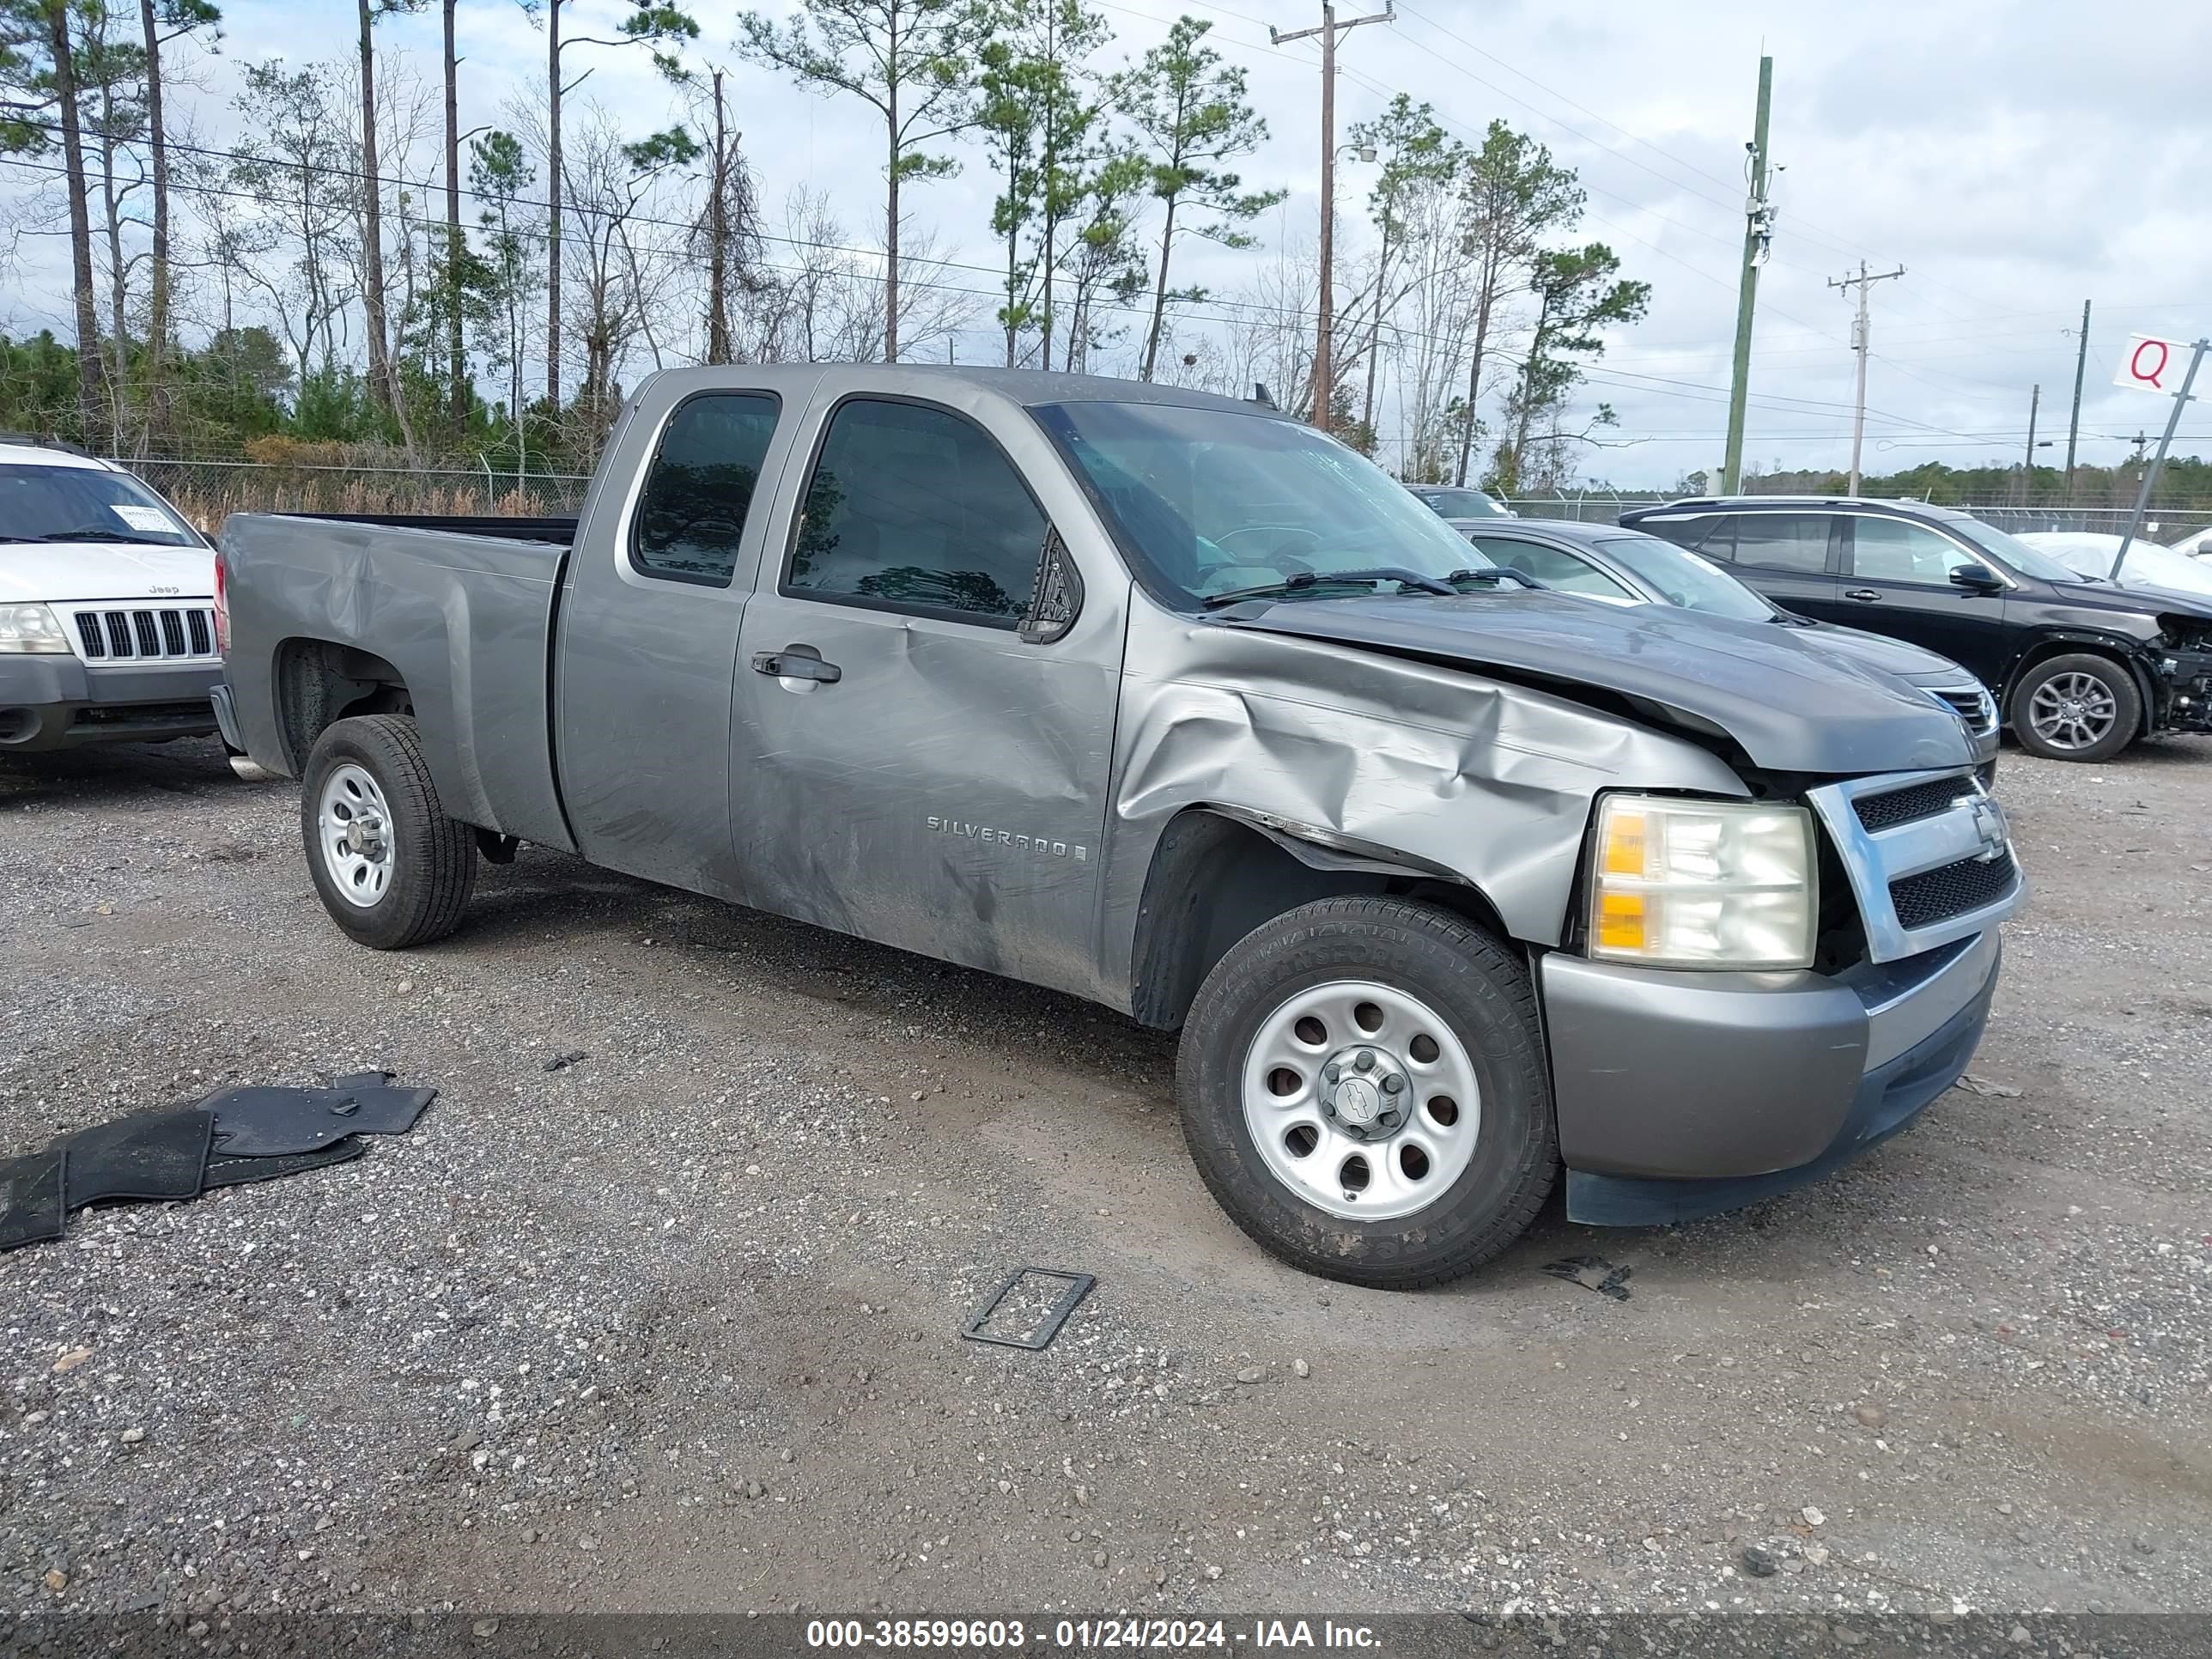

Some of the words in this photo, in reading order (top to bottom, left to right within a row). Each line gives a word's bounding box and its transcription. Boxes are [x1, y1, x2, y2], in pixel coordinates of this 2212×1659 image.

[2131, 340, 2167, 389] Q
[149, 585, 179, 595] Jeep
[927, 816, 1066, 858] SILVERADO
